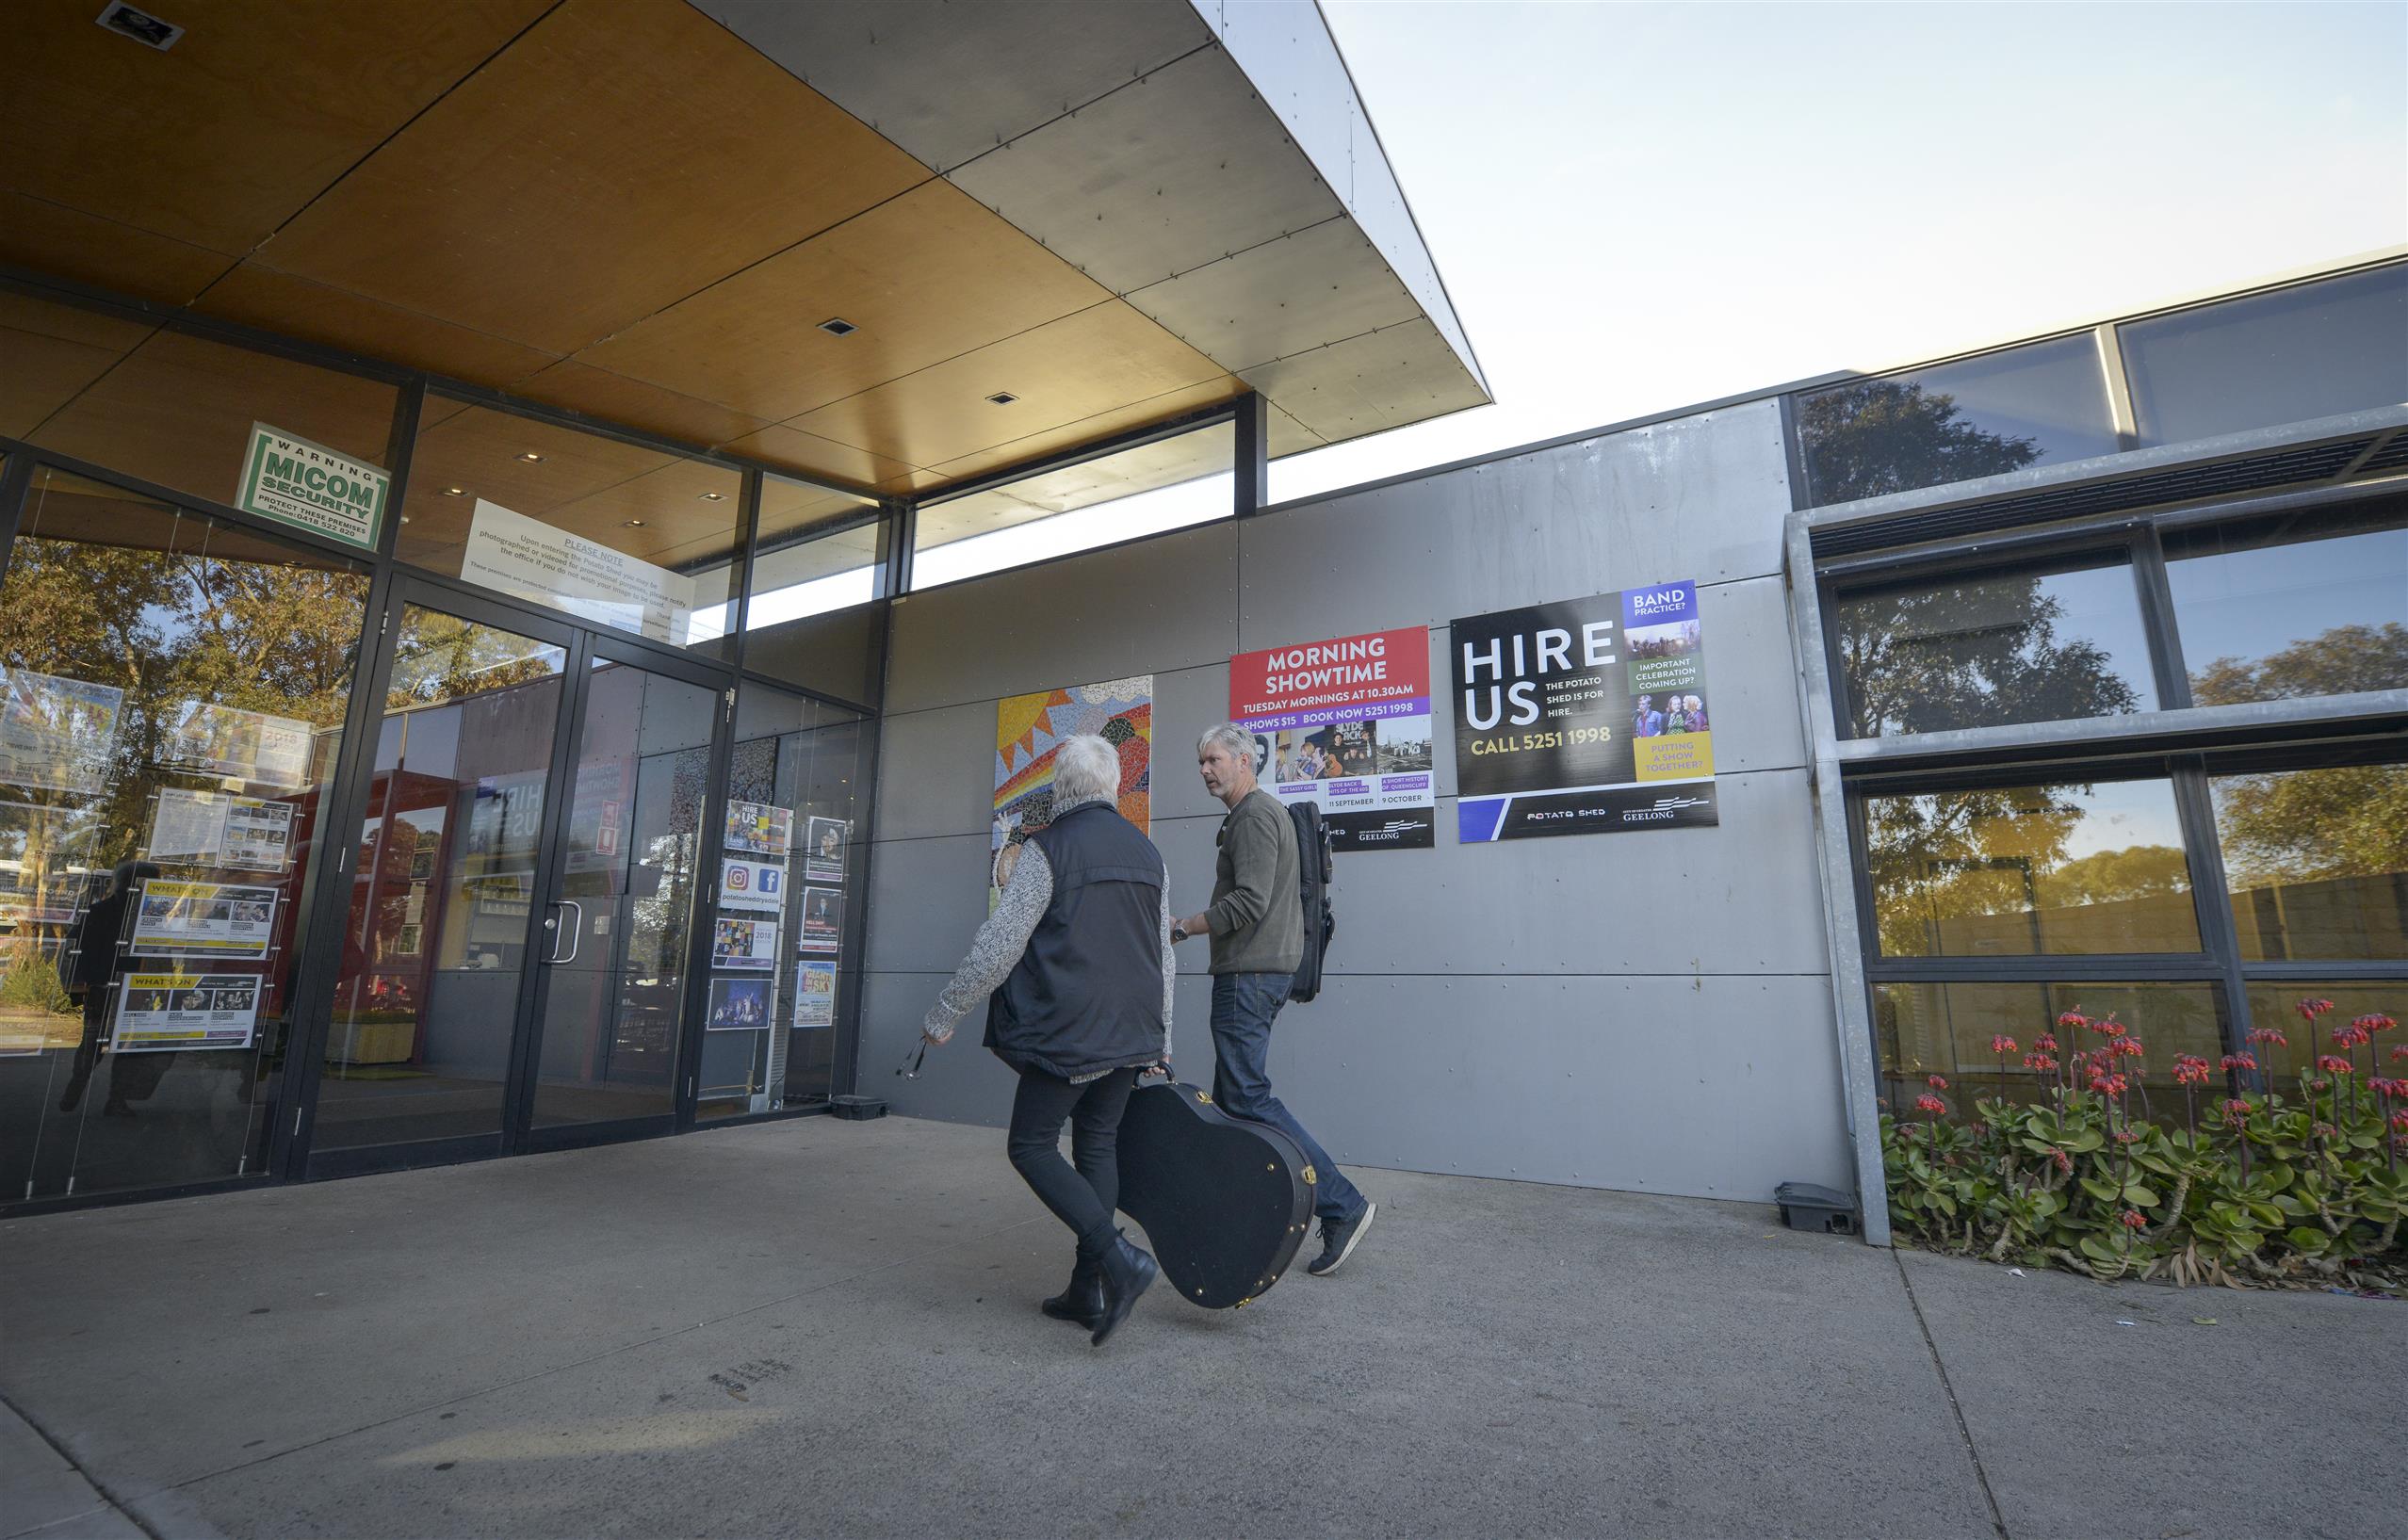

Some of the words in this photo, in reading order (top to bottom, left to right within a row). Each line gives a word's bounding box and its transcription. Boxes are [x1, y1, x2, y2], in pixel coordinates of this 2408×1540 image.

[278, 441, 372, 481] WARNING
[265, 452, 374, 509] MICOM
[262, 477, 370, 519] SECURITY
[258, 494, 298, 511] PROTECT
[301, 508, 326, 521] THESE
[328, 517, 366, 535] PREMISES
[321, 521, 337, 531] 522
[339, 527, 355, 537] 820
[564, 538, 599, 558] PLEASE
[601, 551, 624, 567] NOTE
[479, 529, 530, 553] photographed
[541, 553, 568, 566] videoed
[568, 561, 578, 570] for
[579, 565, 618, 584] promotional
[619, 580, 648, 595] purposes,
[649, 591, 670, 602] please
[670, 596, 687, 608] notify
[520, 535, 540, 547] Upon
[541, 543, 570, 559] entering
[571, 553, 584, 563] the
[583, 556, 605, 571] Potato
[606, 563, 623, 576] Shed
[624, 573, 635, 584] you
[635, 577, 649, 587] may
[650, 580, 658, 590] be
[500, 547, 513, 557] the
[514, 551, 534, 563] office
[543, 562, 556, 572] you
[557, 566, 566, 575] do
[567, 571, 579, 579] not
[580, 575, 596, 586] wish
[596, 581, 612, 592] your
[612, 586, 632, 599] image
[641, 594, 648, 603] be
[1634, 589, 1684, 608] BAND
[1635, 602, 1685, 616] PRACTICE?
[1267, 638, 1385, 673] MORNING
[1464, 621, 1616, 684] HIRE
[1639, 658, 1691, 672] IMPORTANT
[1265, 660, 1387, 695] SHOWTIME
[1635, 667, 1696, 681] CELEBRATION
[1546, 682, 1564, 691] THE
[1566, 677, 1602, 689] POTATO
[1639, 678, 1677, 690] COMING
[1678, 676, 1695, 687] UP?
[1243, 700, 1288, 714] TUESDAY
[1290, 692, 1349, 708] MORNINGS
[1352, 689, 1365, 700] AT
[1367, 684, 1413, 699] 10.30AM
[1546, 694, 1571, 705] SHED
[1573, 692, 1583, 701] IS
[1585, 690, 1603, 700] FOR
[1465, 681, 1539, 730] US
[1547, 707, 1573, 718] HIRE.
[1244, 718, 1279, 731] SHOWS
[1281, 716, 1296, 727] $15
[1303, 711, 1334, 724] BOOK
[1336, 707, 1363, 720] NOW
[1365, 705, 1388, 716] 5251
[1389, 702, 1413, 714] 1998
[1335, 721, 1364, 735] SLYDE
[1471, 737, 1520, 755] CALL
[1523, 732, 1563, 750] 5251
[1568, 726, 1611, 745] 1998
[1651, 742, 1694, 754] PUTTING
[1653, 754, 1661, 762] A
[1663, 752, 1694, 762] SHOW
[1645, 760, 1703, 772] TOGETHER?
[1388, 795, 1422, 803] OCTOBER
[741, 805, 757, 815] HIRE
[1527, 810, 1574, 820] POTATO
[1578, 808, 1605, 817] SHED
[1622, 810, 1674, 821] GEELONG
[741, 812, 757, 825] US
[1359, 833, 1400, 841] GEELONG
[722, 894, 779, 904] potatosheddrysdale
[756, 932, 772, 940] 2018
